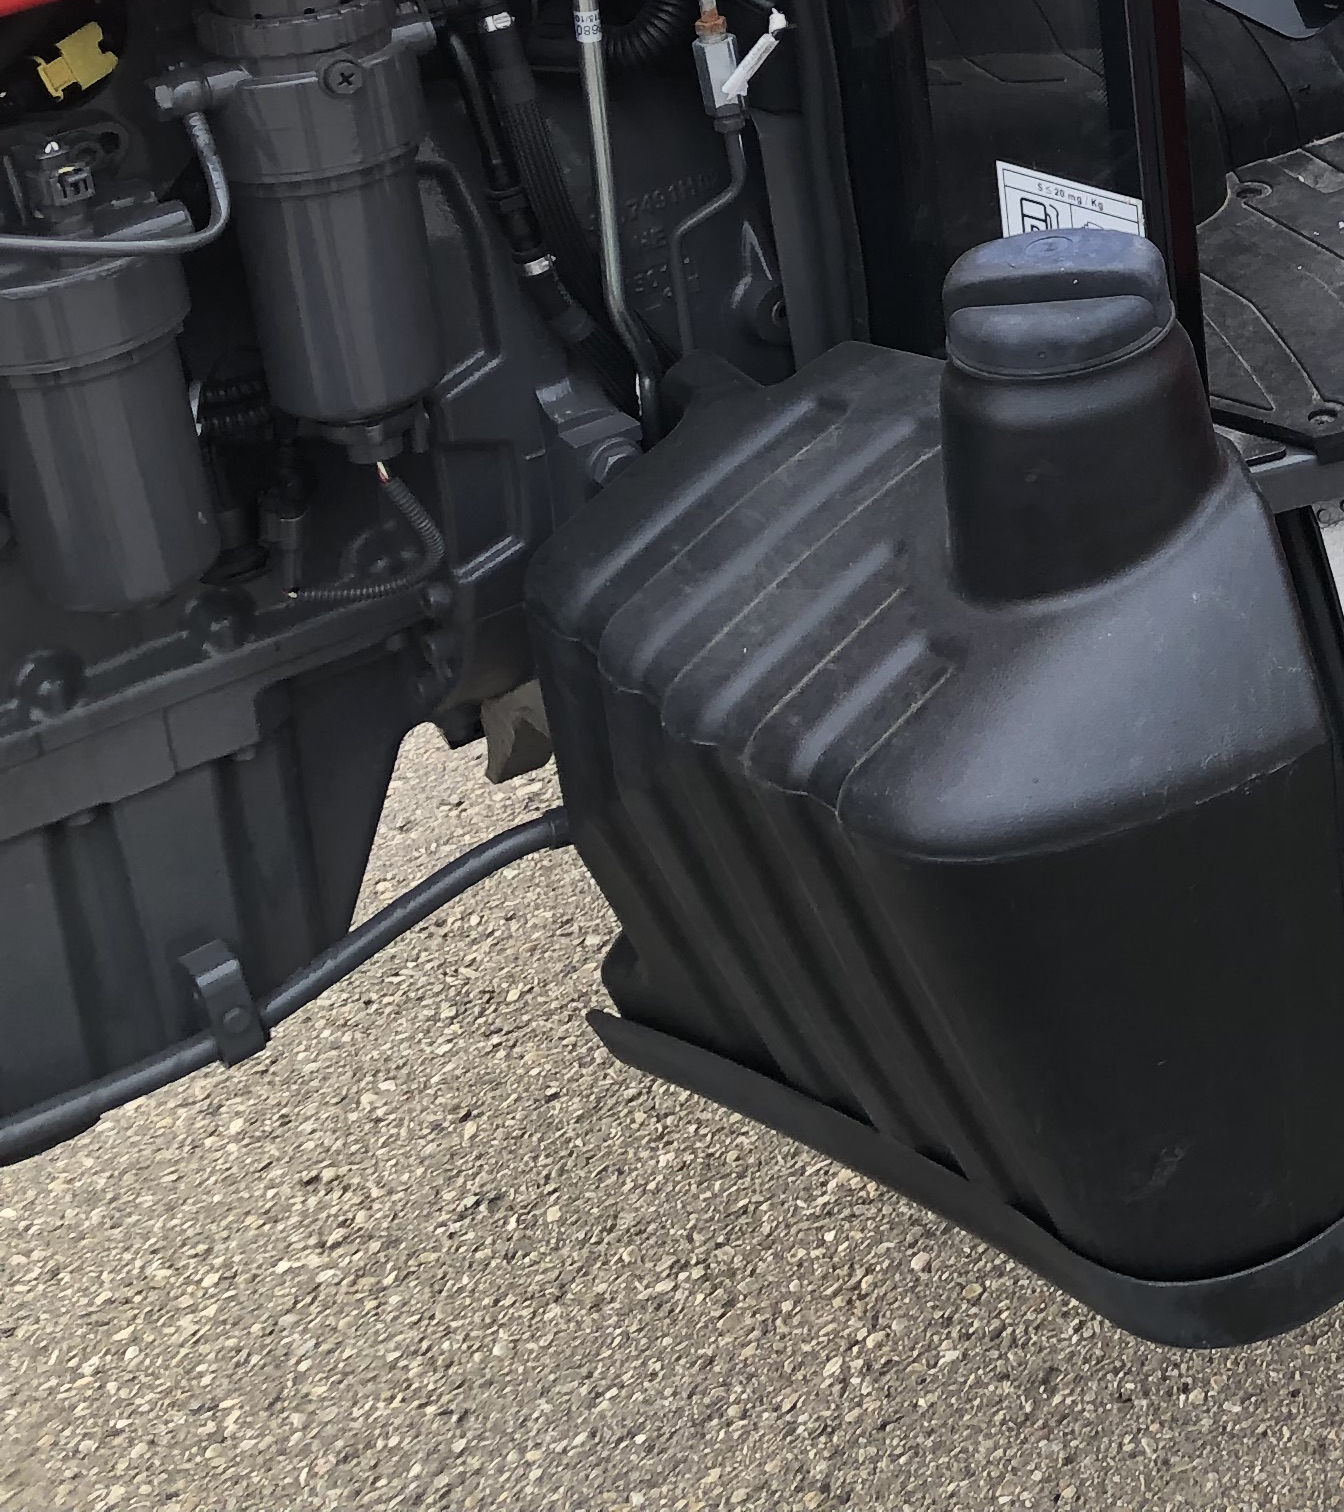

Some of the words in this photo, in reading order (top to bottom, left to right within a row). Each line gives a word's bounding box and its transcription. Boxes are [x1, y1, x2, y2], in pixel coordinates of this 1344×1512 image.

[1037, 181, 1044, 192] S
[1054, 188, 1066, 199] 20
[1067, 193, 1083, 206] mg
[1090, 198, 1105, 212] Kg
